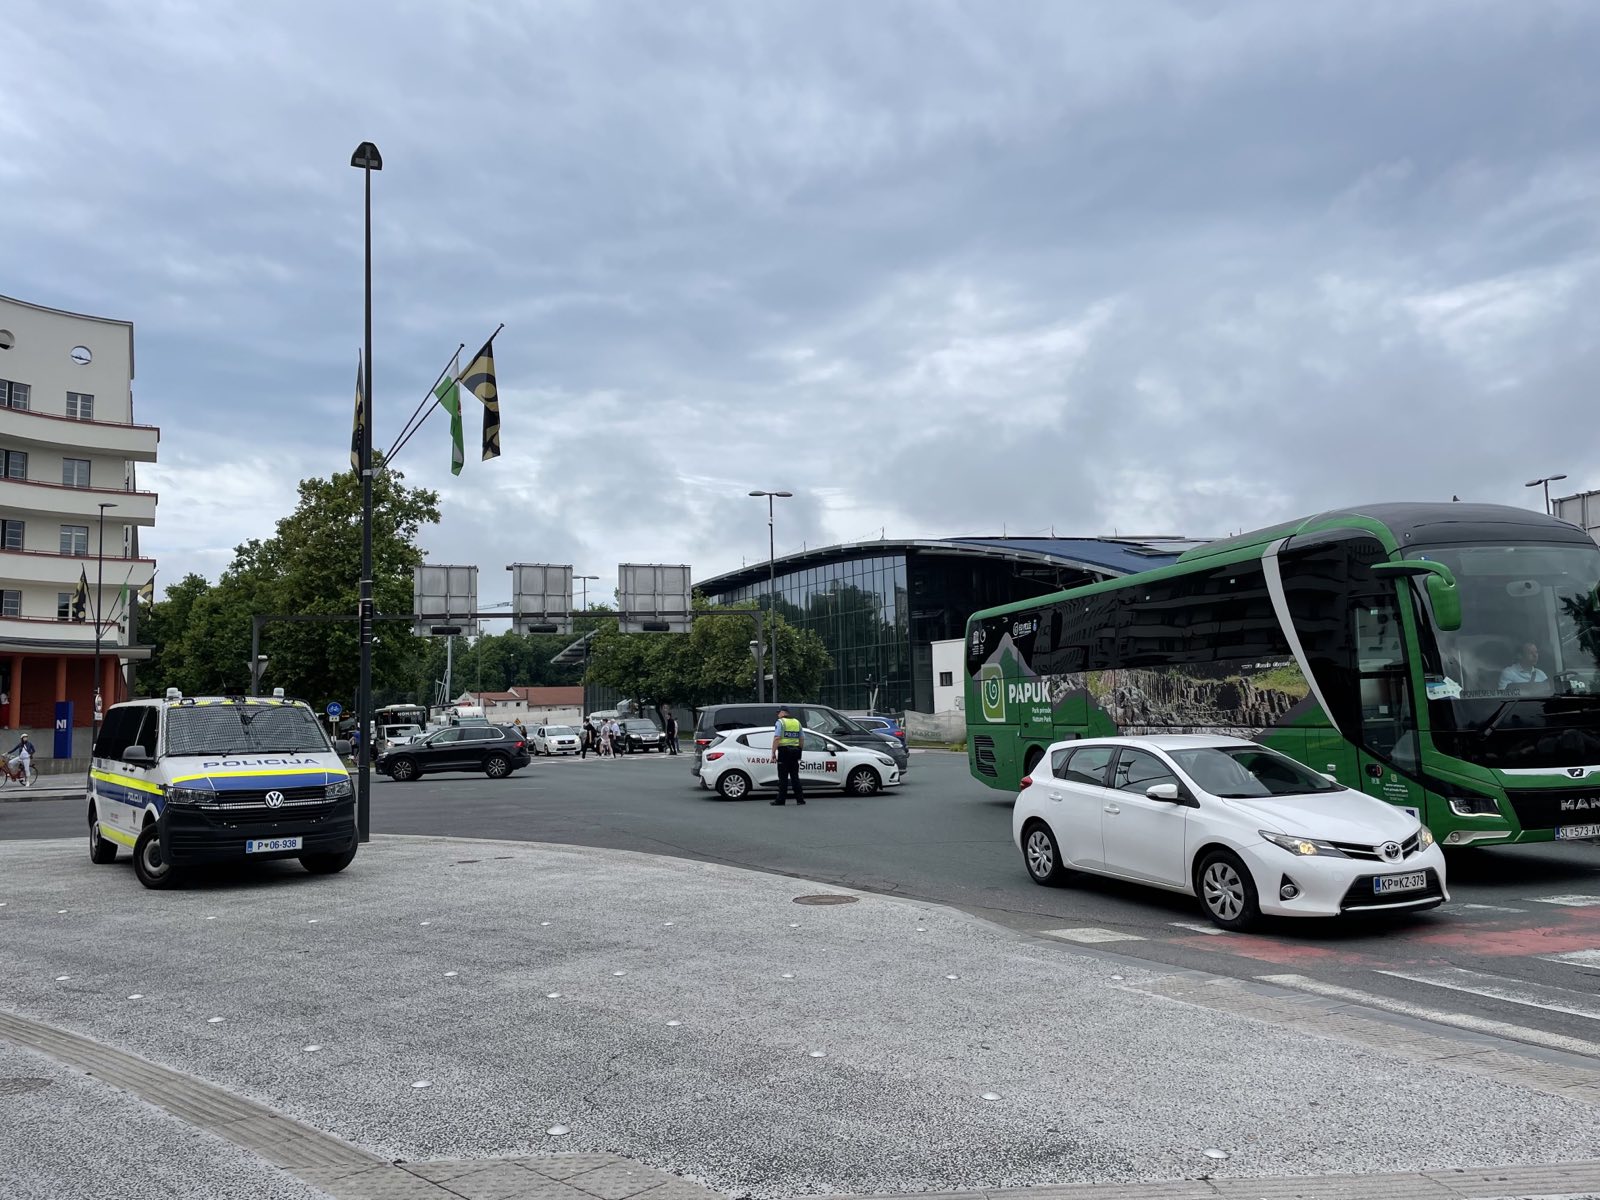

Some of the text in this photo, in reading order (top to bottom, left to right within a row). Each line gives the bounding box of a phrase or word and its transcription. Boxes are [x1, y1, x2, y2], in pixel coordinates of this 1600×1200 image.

[1008, 680, 1052, 703] PAPUK
[203, 758, 320, 768] POLICIJA
[799, 761, 825, 771] Sintal
[257, 839, 297, 851] P 06-938
[1381, 874, 1425, 891] KP KZ-379
